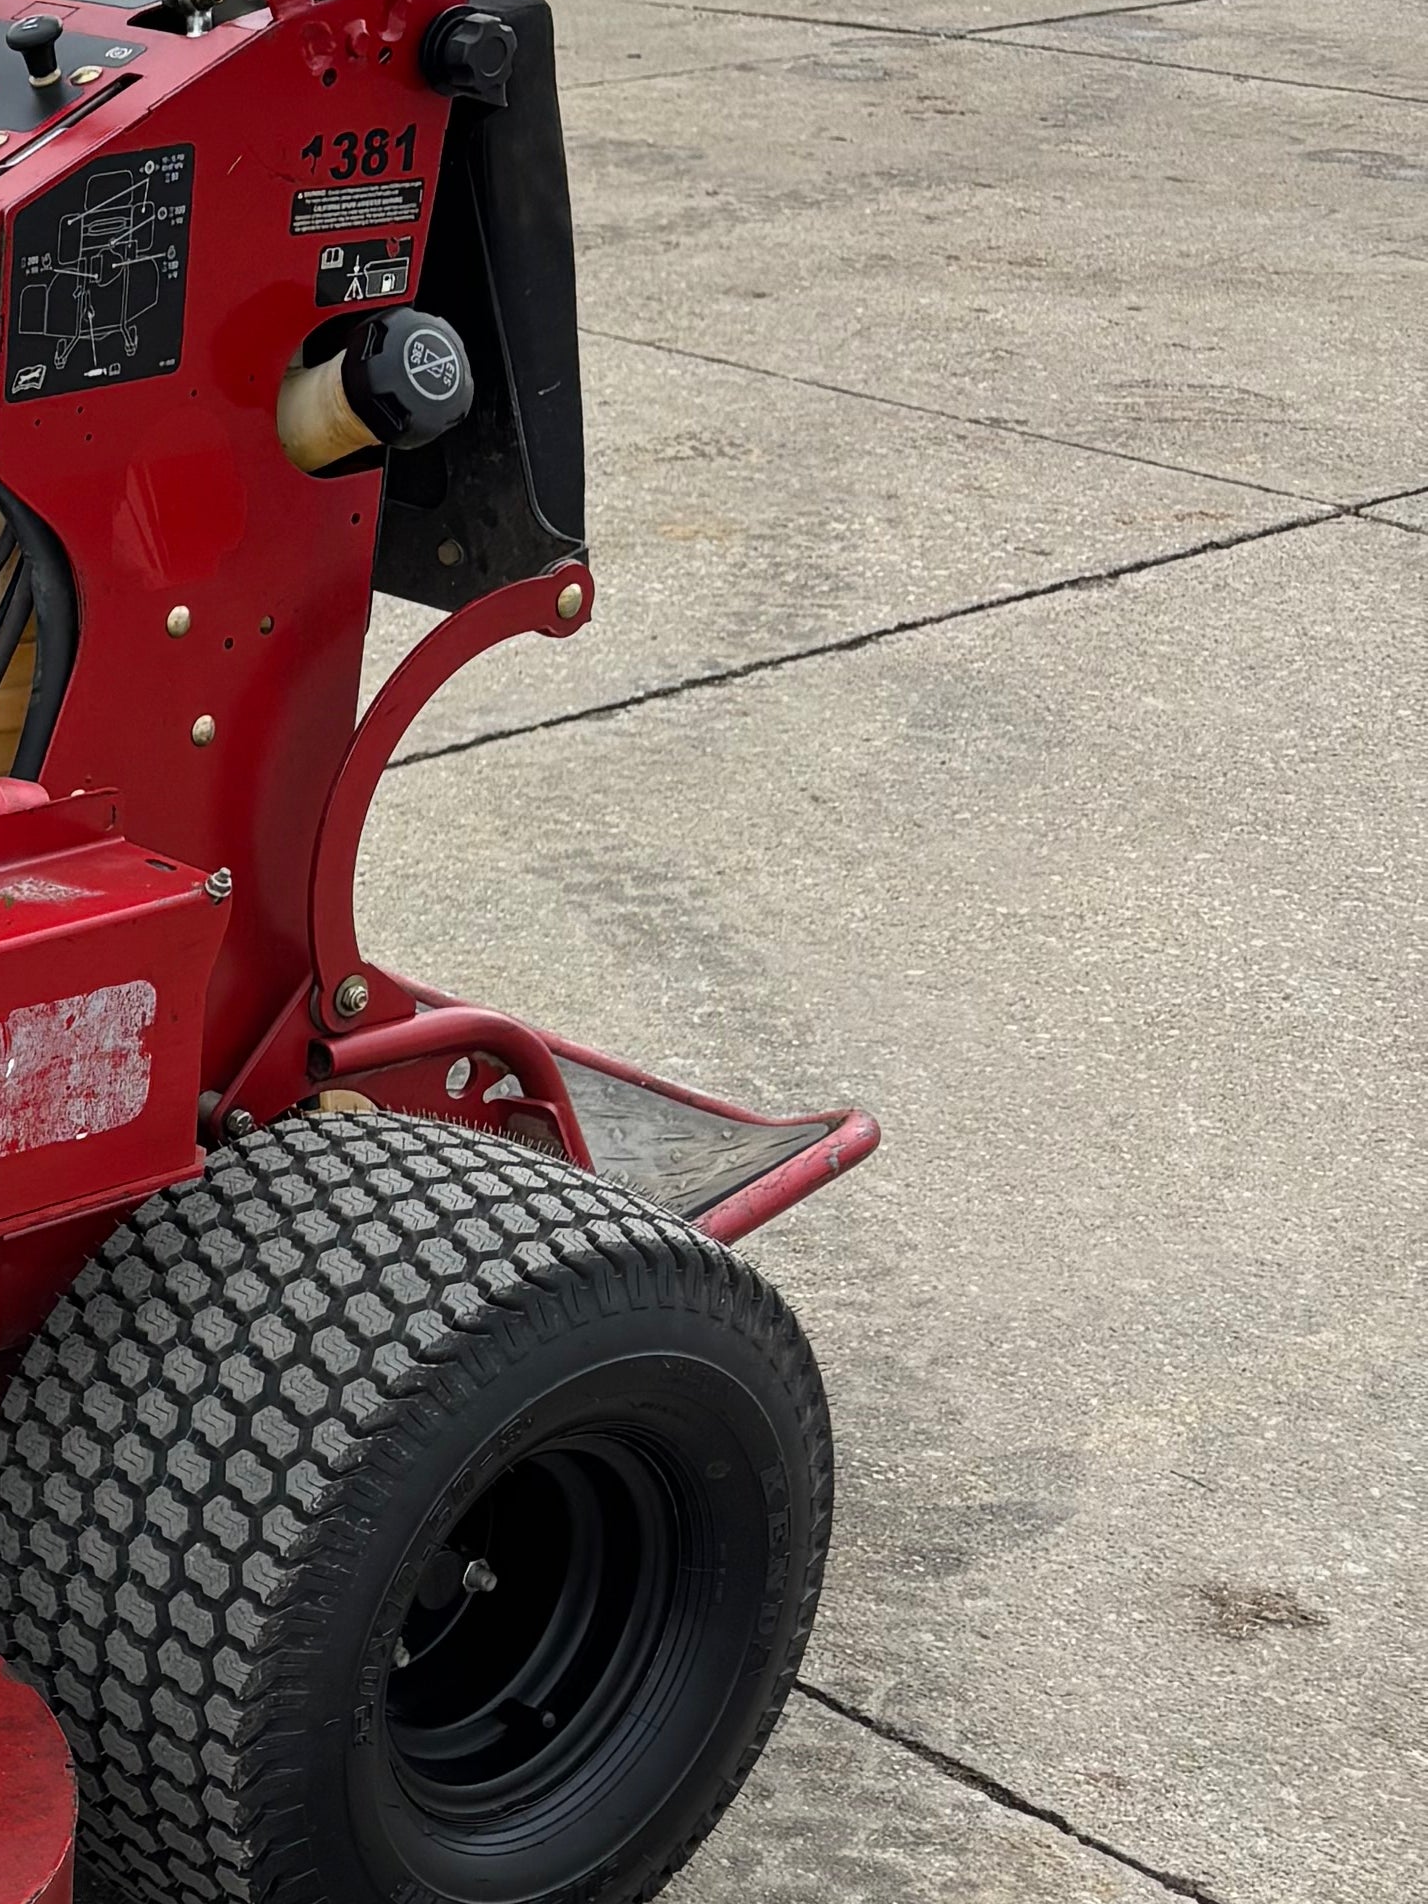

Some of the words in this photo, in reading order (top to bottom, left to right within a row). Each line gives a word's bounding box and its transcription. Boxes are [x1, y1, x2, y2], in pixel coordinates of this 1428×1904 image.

[410, 341, 425, 365] E85
[443, 362, 456, 387] E15
[746, 1459, 792, 1677] KENDA
